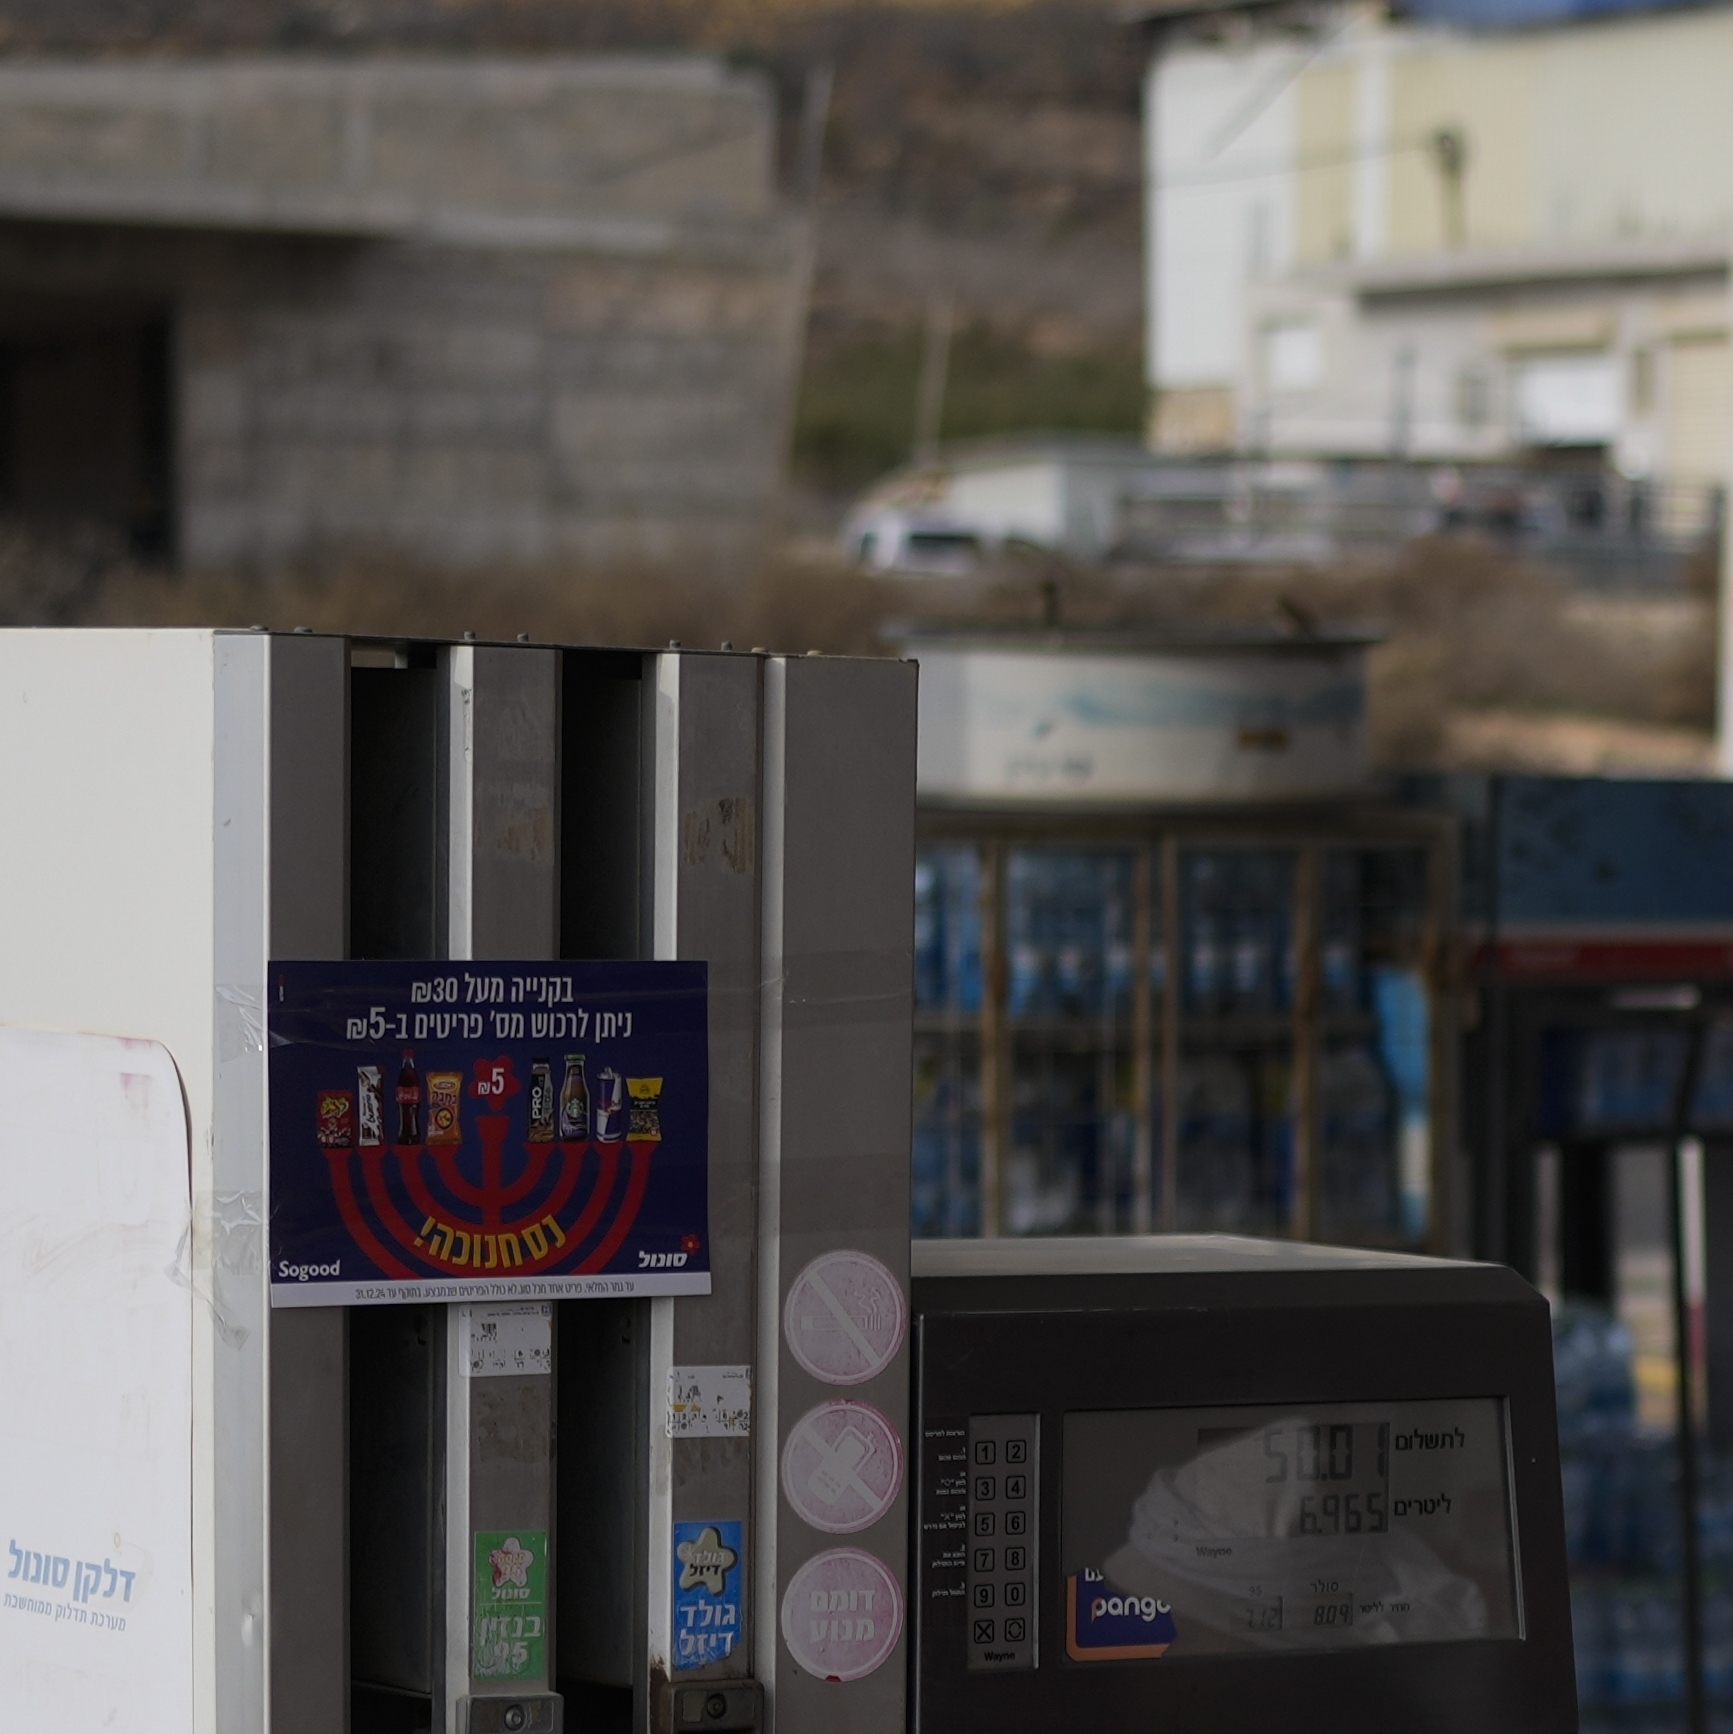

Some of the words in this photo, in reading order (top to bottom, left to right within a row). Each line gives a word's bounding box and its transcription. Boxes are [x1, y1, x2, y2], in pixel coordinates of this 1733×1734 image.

[465, 972, 504, 1003] מעל
[511, 977, 574, 1008] בקנייה
[415, 1012, 483, 1040] פריטים
[531, 1008, 588, 1039] לרכוש
[595, 1011, 633, 1043] ניתן
[532, 1086, 541, 1120] PRO
[413, 1216, 523, 1268] חנוכה!
[521, 1214, 566, 1260] נס
[278, 1259, 340, 1282] Sogood
[638, 1250, 687, 1268] סונול
[1395, 1428, 1464, 1451] לתשלום
[981, 1446, 989, 1460] 1
[1012, 1445, 1020, 1459] 2
[981, 1482, 989, 1496] 3
[1011, 1480, 1020, 1494] 4
[1394, 1493, 1452, 1516] ליטרים
[981, 1517, 989, 1531] 5
[1011, 1516, 1020, 1530] 6
[8, 1539, 70, 1589] סונול
[981, 1553, 989, 1568] 7
[1011, 1551, 1020, 1566] 8
[72, 1558, 136, 1604] דלקן
[1310, 1580, 1338, 1593] סולר
[4, 1593, 52, 1616] ממוחשבת
[810, 1591, 876, 1613] דומם
[980, 1588, 989, 1603] 9
[1011, 1587, 1020, 1601] 0
[55, 1603, 87, 1623] תדלוק
[90, 1610, 126, 1631] מערכת
[680, 1601, 736, 1627] גולד
[809, 1619, 876, 1643] מנוע
[680, 1629, 733, 1657] דיזל
[984, 1651, 1015, 1662] Wayne
